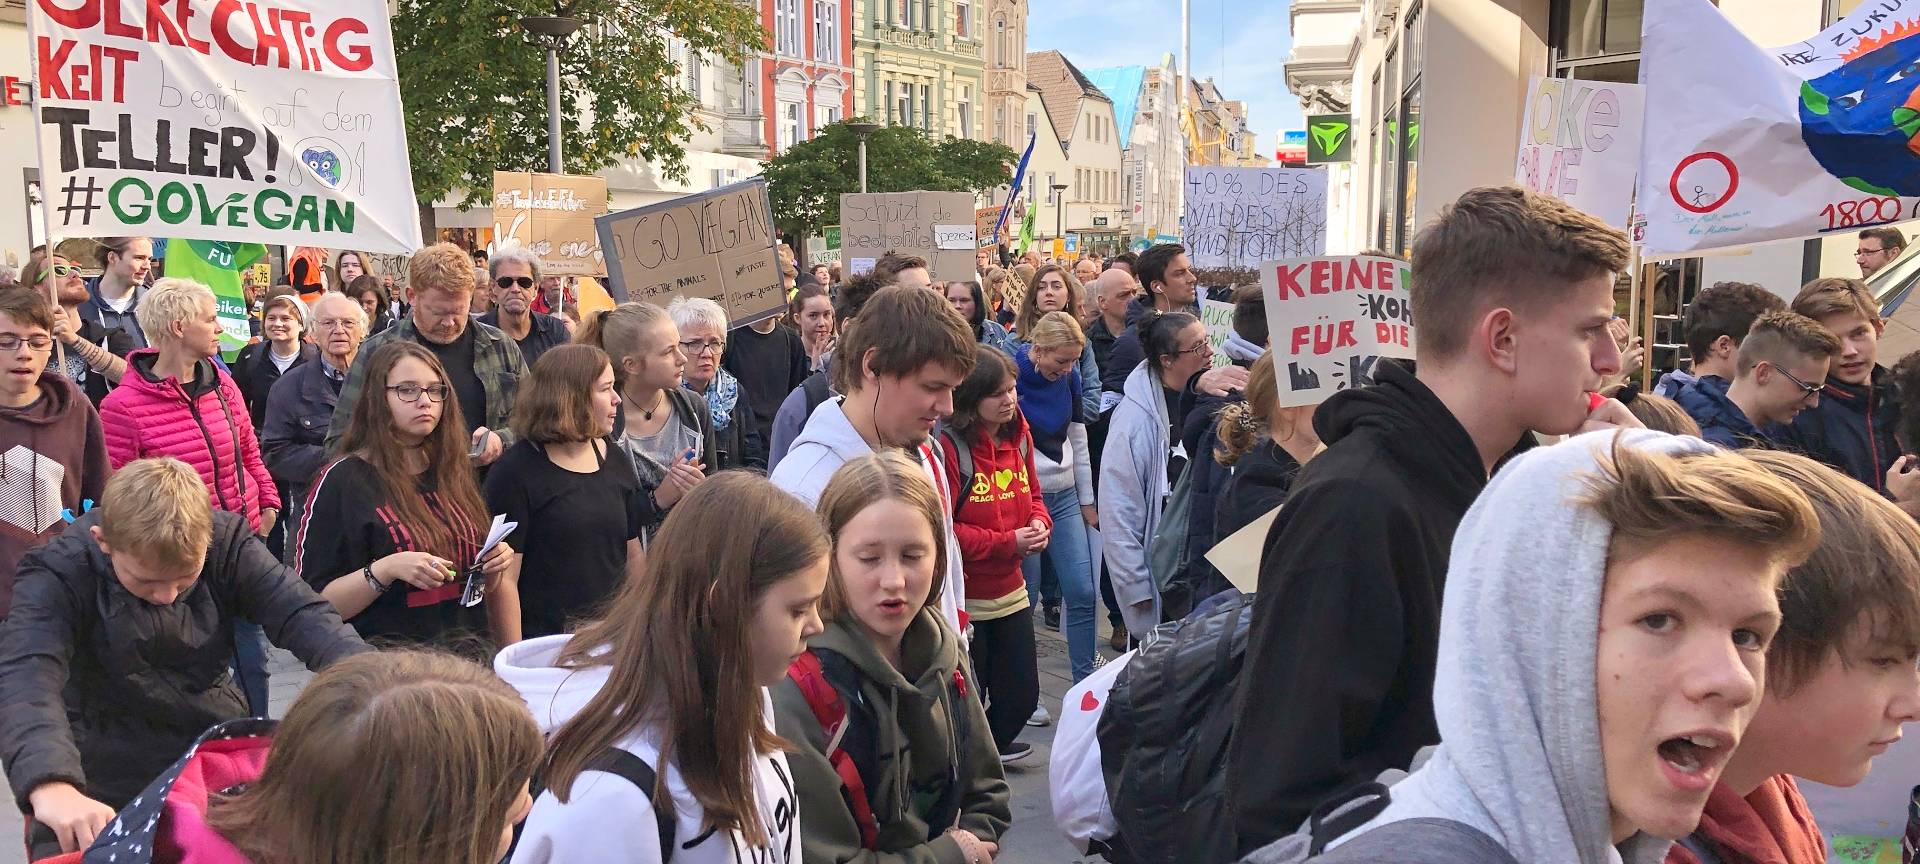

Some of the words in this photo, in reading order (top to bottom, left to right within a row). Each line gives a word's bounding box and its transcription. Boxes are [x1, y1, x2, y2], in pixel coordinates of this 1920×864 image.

[37, 36, 139, 103] KEIT
[262, 88, 310, 128] auf
[322, 90, 372, 132] dem
[41, 106, 280, 184] TELLER!
[1188, 171, 1243, 196] 40%
[1260, 172, 1308, 195] DES
[57, 176, 355, 234] #GOVEGAN
[846, 195, 919, 222] Schützt
[933, 200, 951, 221] die
[1186, 200, 1274, 229] WALDES
[1819, 196, 1902, 231] 1800
[632, 212, 680, 270] GO
[687, 186, 771, 255] VEGAN
[1095, 217, 1106, 225] Tee
[208, 248, 232, 266] FU
[1186, 232, 1228, 257] SIND
[660, 282, 673, 293] THE
[1276, 258, 1394, 300] KEINE
[1290, 316, 1358, 355] FÜR
[1375, 322, 1408, 348] DIE
[998, 491, 1015, 500] LOVE
